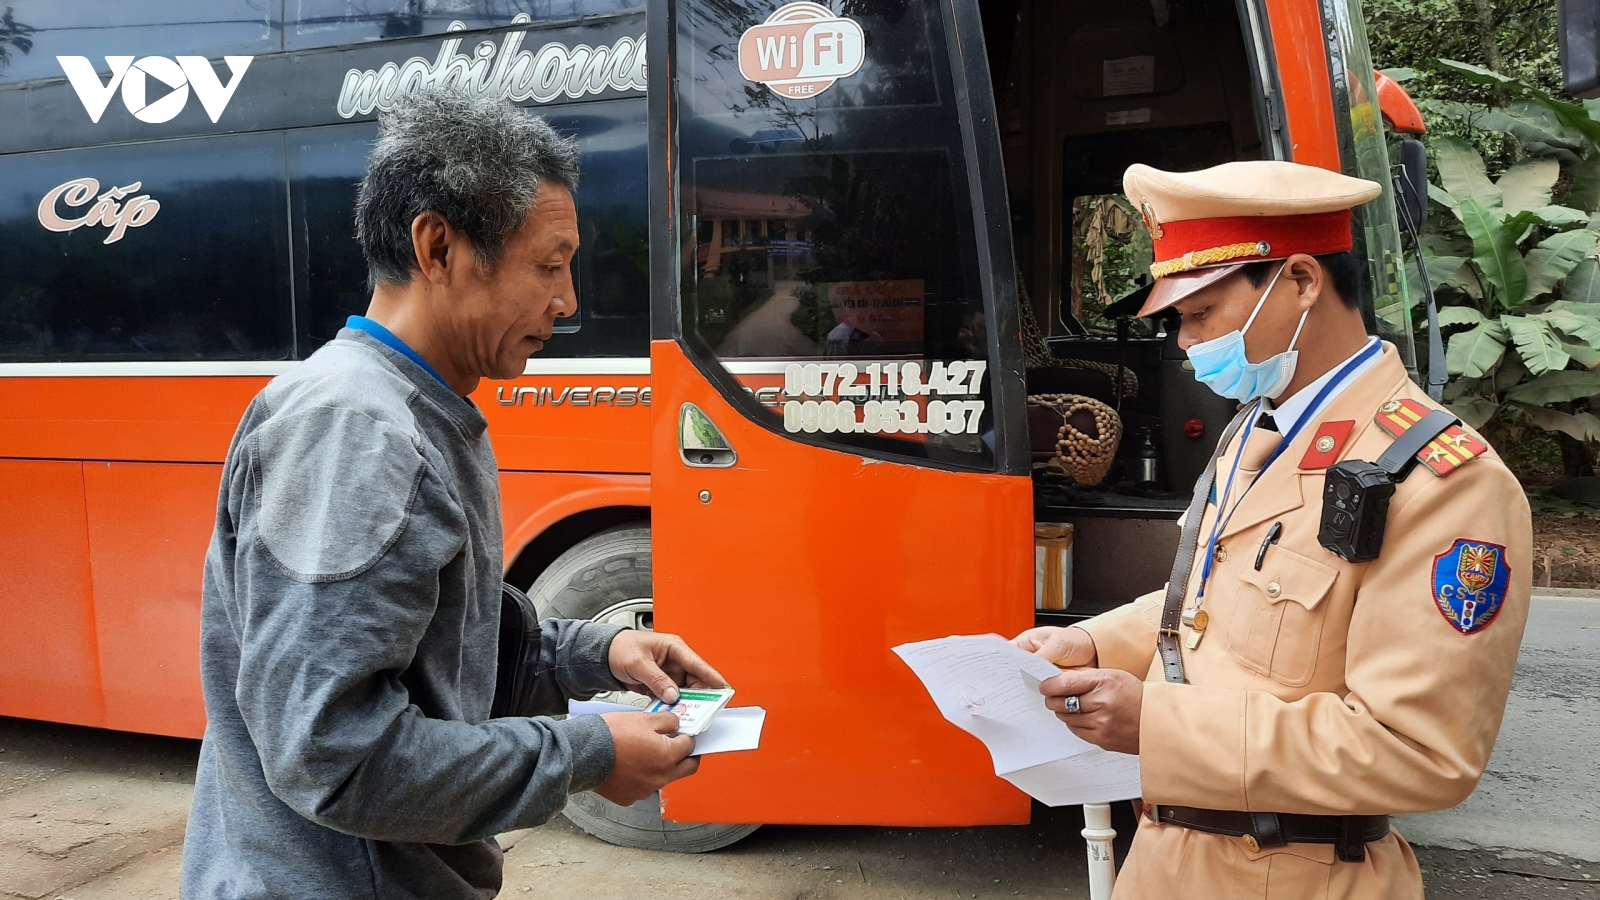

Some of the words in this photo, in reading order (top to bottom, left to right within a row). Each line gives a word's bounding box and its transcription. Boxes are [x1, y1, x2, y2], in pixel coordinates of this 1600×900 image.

[788, 84, 815, 95] FREE
[37, 177, 161, 245] Cấp
[784, 360, 987, 396] 0972.118.427
[783, 400, 985, 434] 0986.853.037
